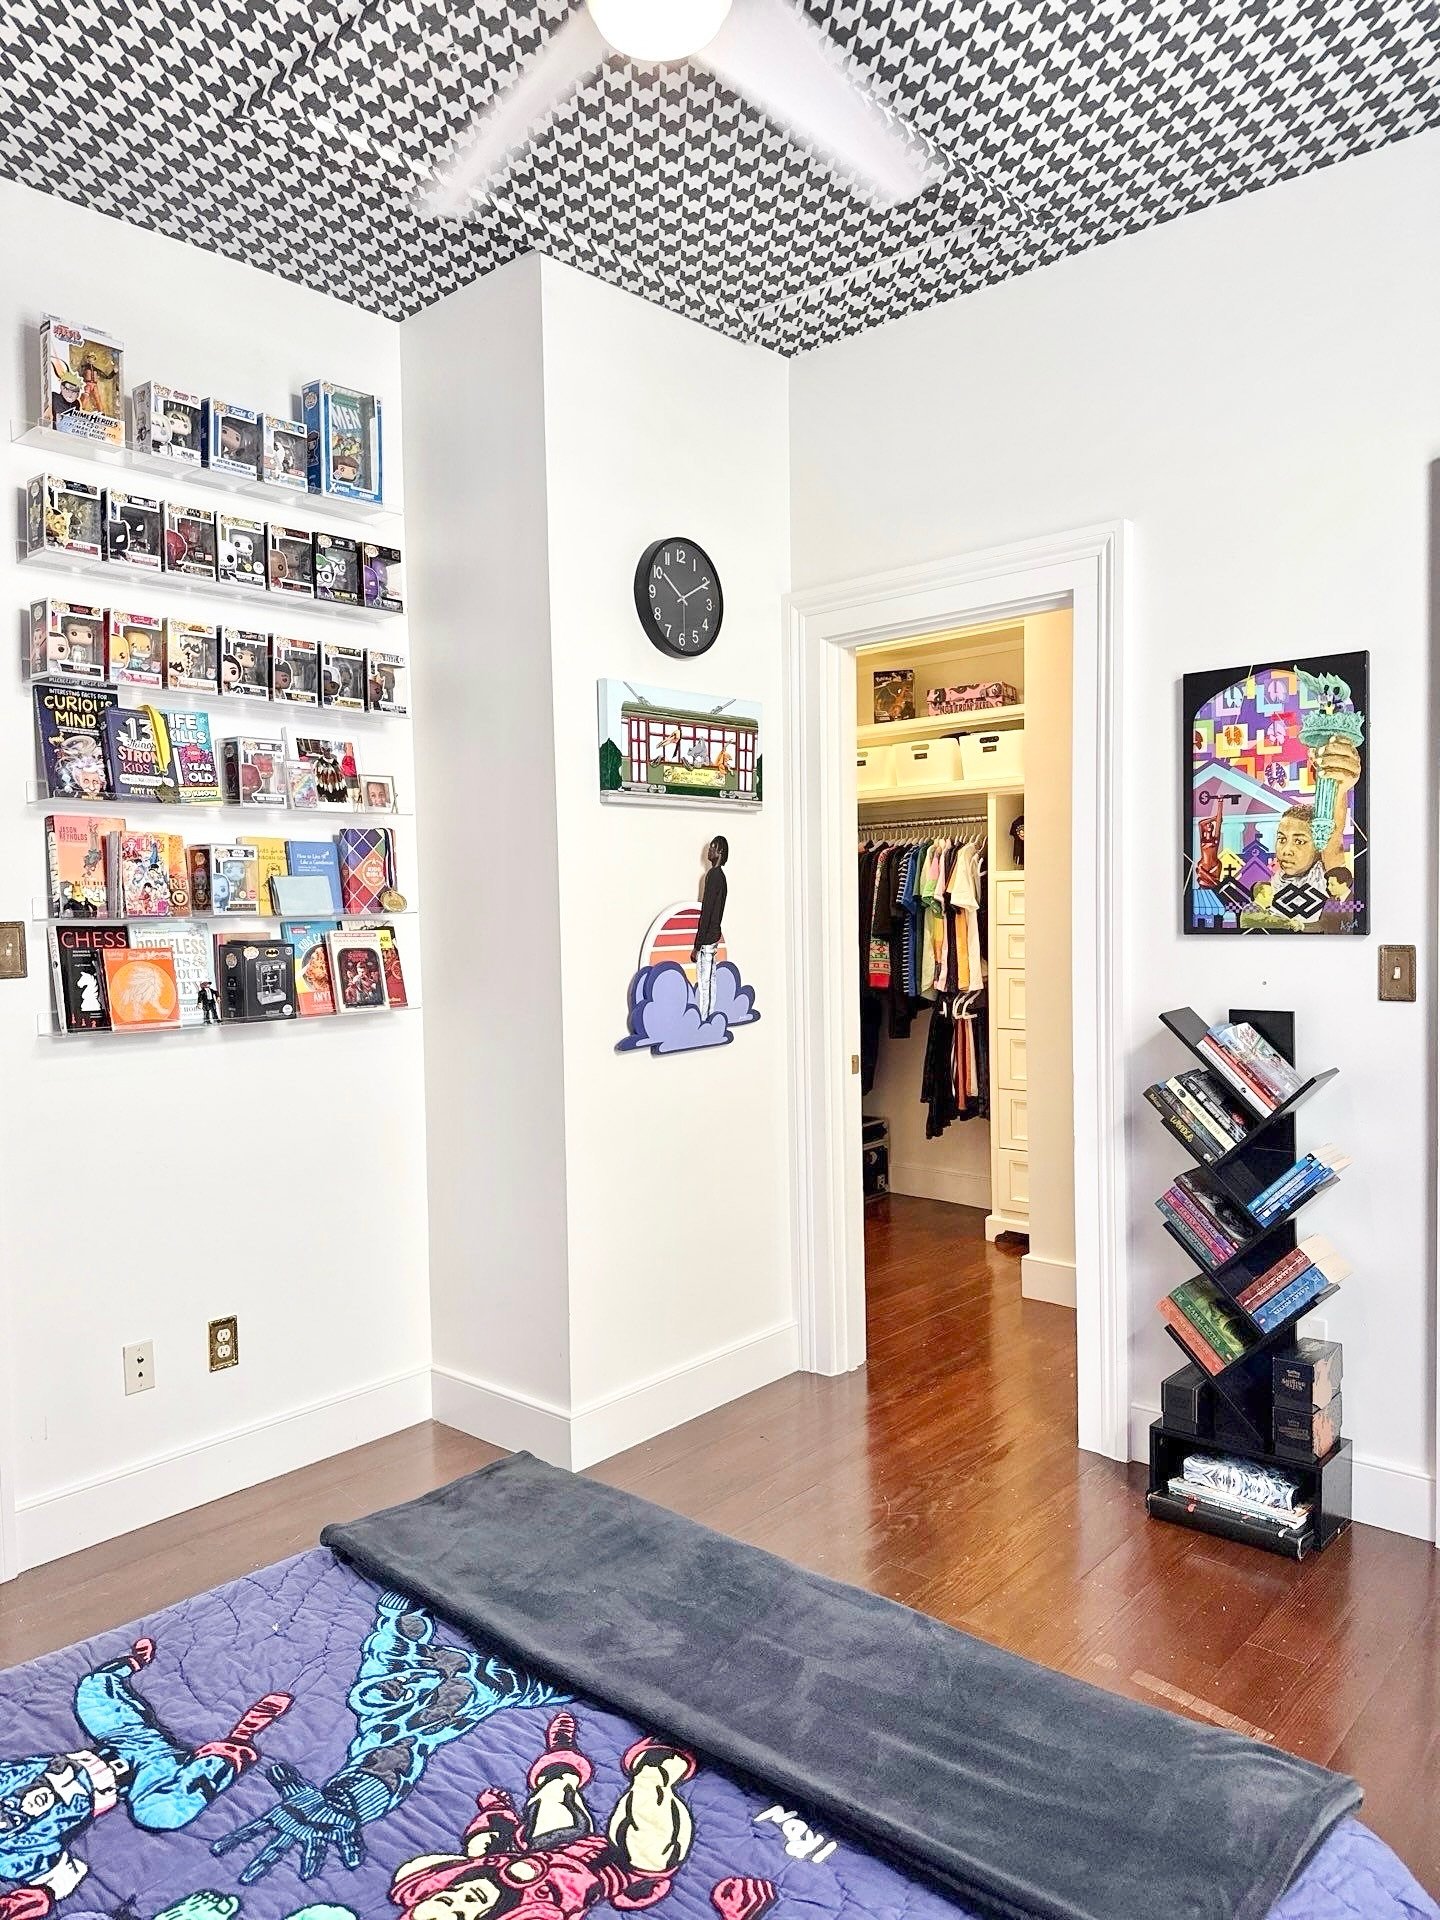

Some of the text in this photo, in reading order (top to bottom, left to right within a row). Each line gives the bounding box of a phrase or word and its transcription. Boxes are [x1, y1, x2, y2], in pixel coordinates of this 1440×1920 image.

[665, 551, 671, 566] 11
[676, 549, 686, 564] 12
[653, 564, 663, 580] 10
[693, 558, 697, 572] 1
[702, 576, 711, 590] 2
[649, 584, 656, 599] 9
[706, 598, 713, 611] 3
[654, 606, 661, 620] 8
[664, 624, 672, 638] 7
[702, 618, 709, 632] 4
[679, 632, 686, 646] 6
[692, 630, 699, 644] 5
[55, 711, 97, 729] MIND
[167, 712, 198, 730] IFE
[169, 729, 207, 744] KILLS
[118, 745, 159, 763] STRON
[122, 762, 150, 774] KIDS
[187, 762, 212, 772] YEAR
[188, 772, 214, 783] OLD
[61, 931, 127, 948] CHESS
[1169, 1115, 1194, 1142] WONDER
[754, 1805, 837, 1863] IRON
